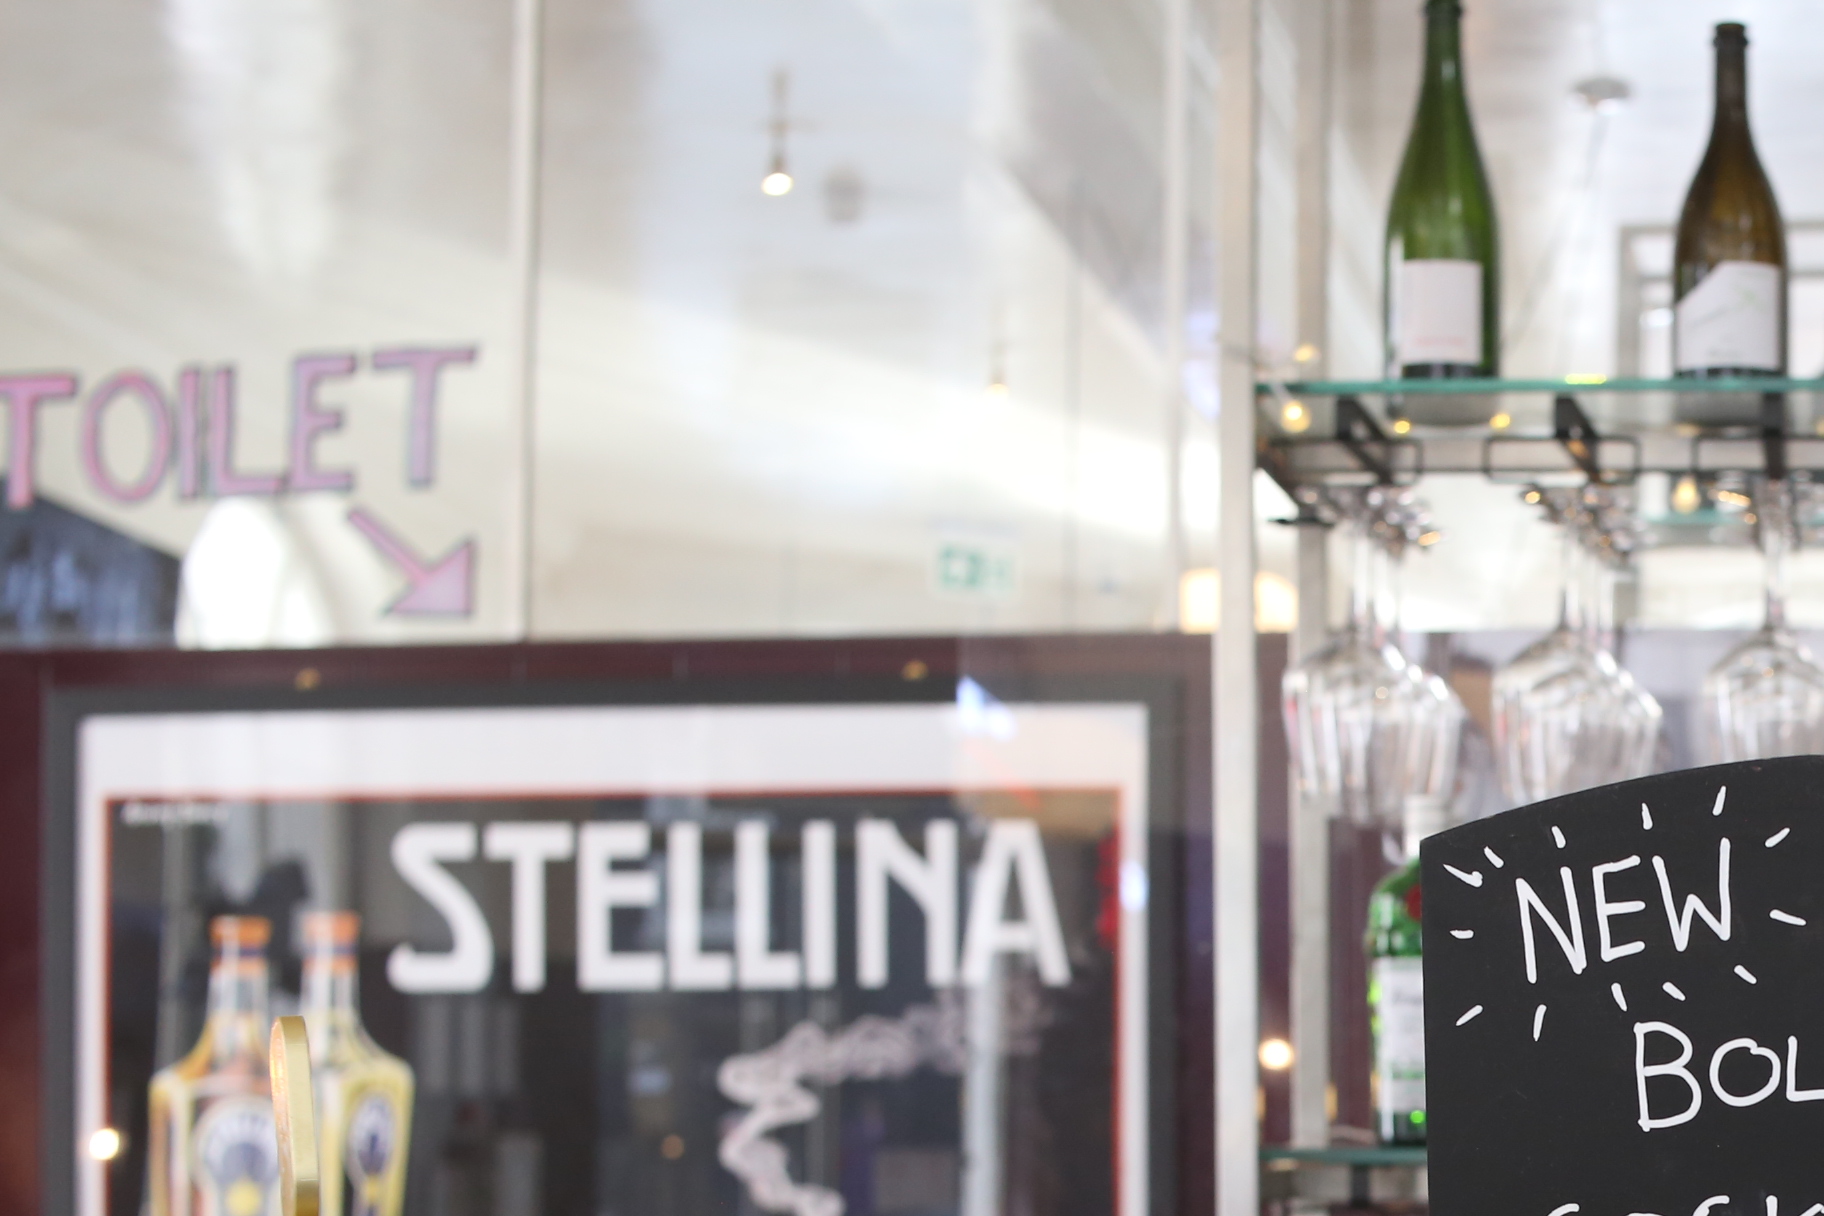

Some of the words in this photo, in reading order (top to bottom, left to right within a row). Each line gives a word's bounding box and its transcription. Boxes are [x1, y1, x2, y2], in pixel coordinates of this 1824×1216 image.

[0, 342, 477, 508] TOILET
[386, 819, 1072, 992] STELLINA
[1515, 836, 1731, 984] NEW
